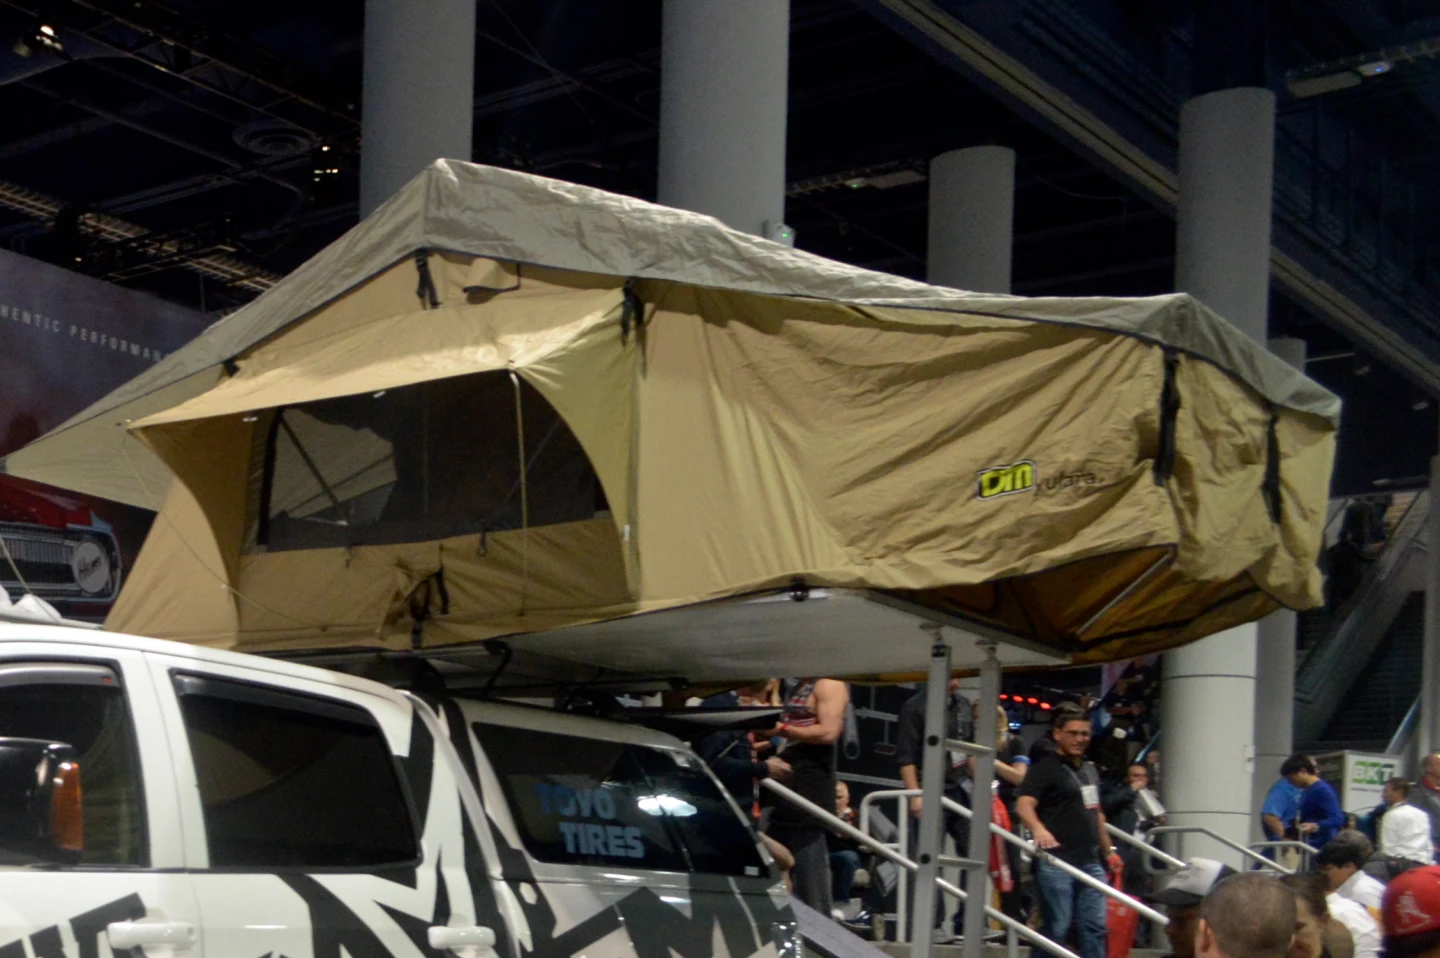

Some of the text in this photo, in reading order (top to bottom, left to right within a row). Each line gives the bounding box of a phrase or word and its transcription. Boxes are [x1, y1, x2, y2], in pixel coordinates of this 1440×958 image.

[70, 325, 168, 362] PERFORMAN
[536, 784, 616, 820] TOYO
[559, 822, 645, 859] TIRES
